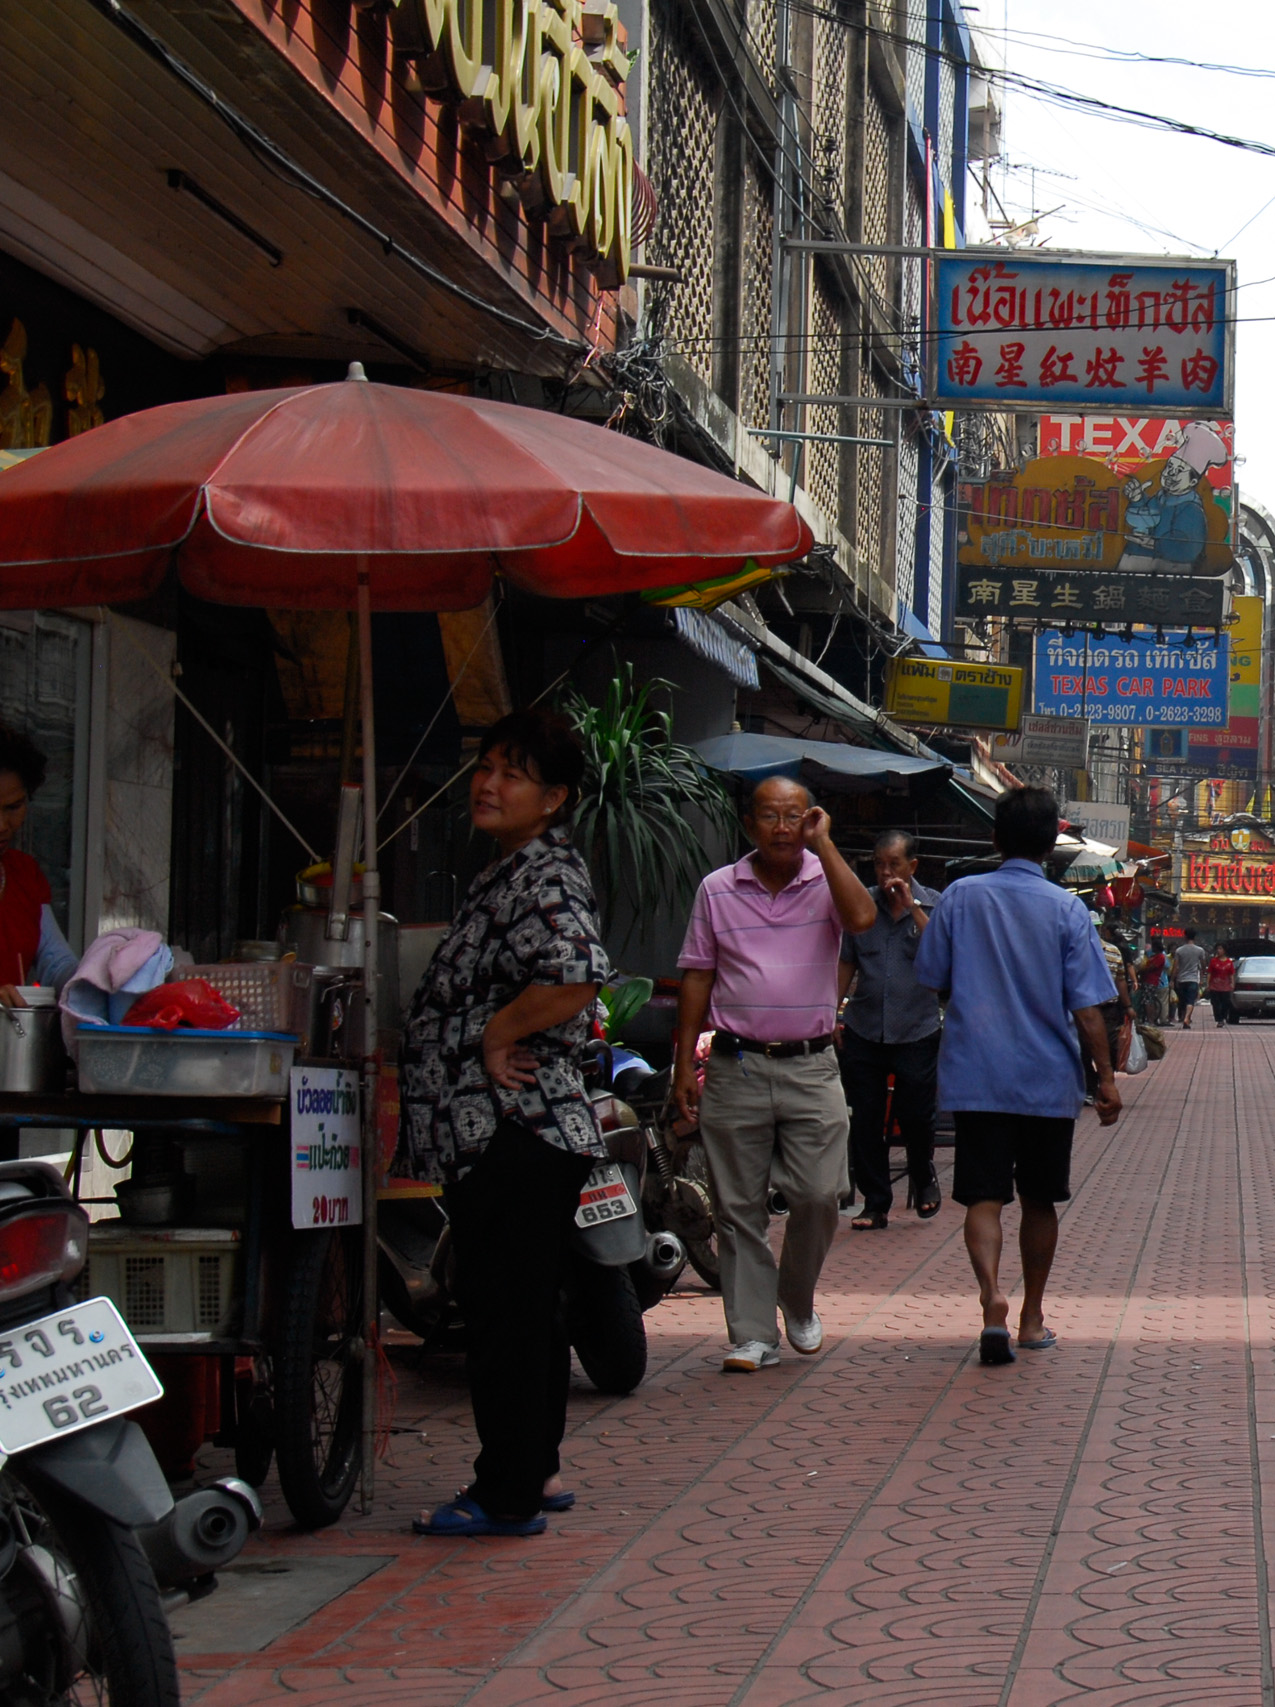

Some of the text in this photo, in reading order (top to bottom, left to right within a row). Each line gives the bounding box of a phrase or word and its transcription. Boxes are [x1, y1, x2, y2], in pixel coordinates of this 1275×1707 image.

[1051, 675, 1212, 698] TEXAS CAR PARK
[1146, 706, 1222, 722] 0-2623-3298
[582, 1199, 627, 1223] 653
[42, 1384, 109, 1429] 62
